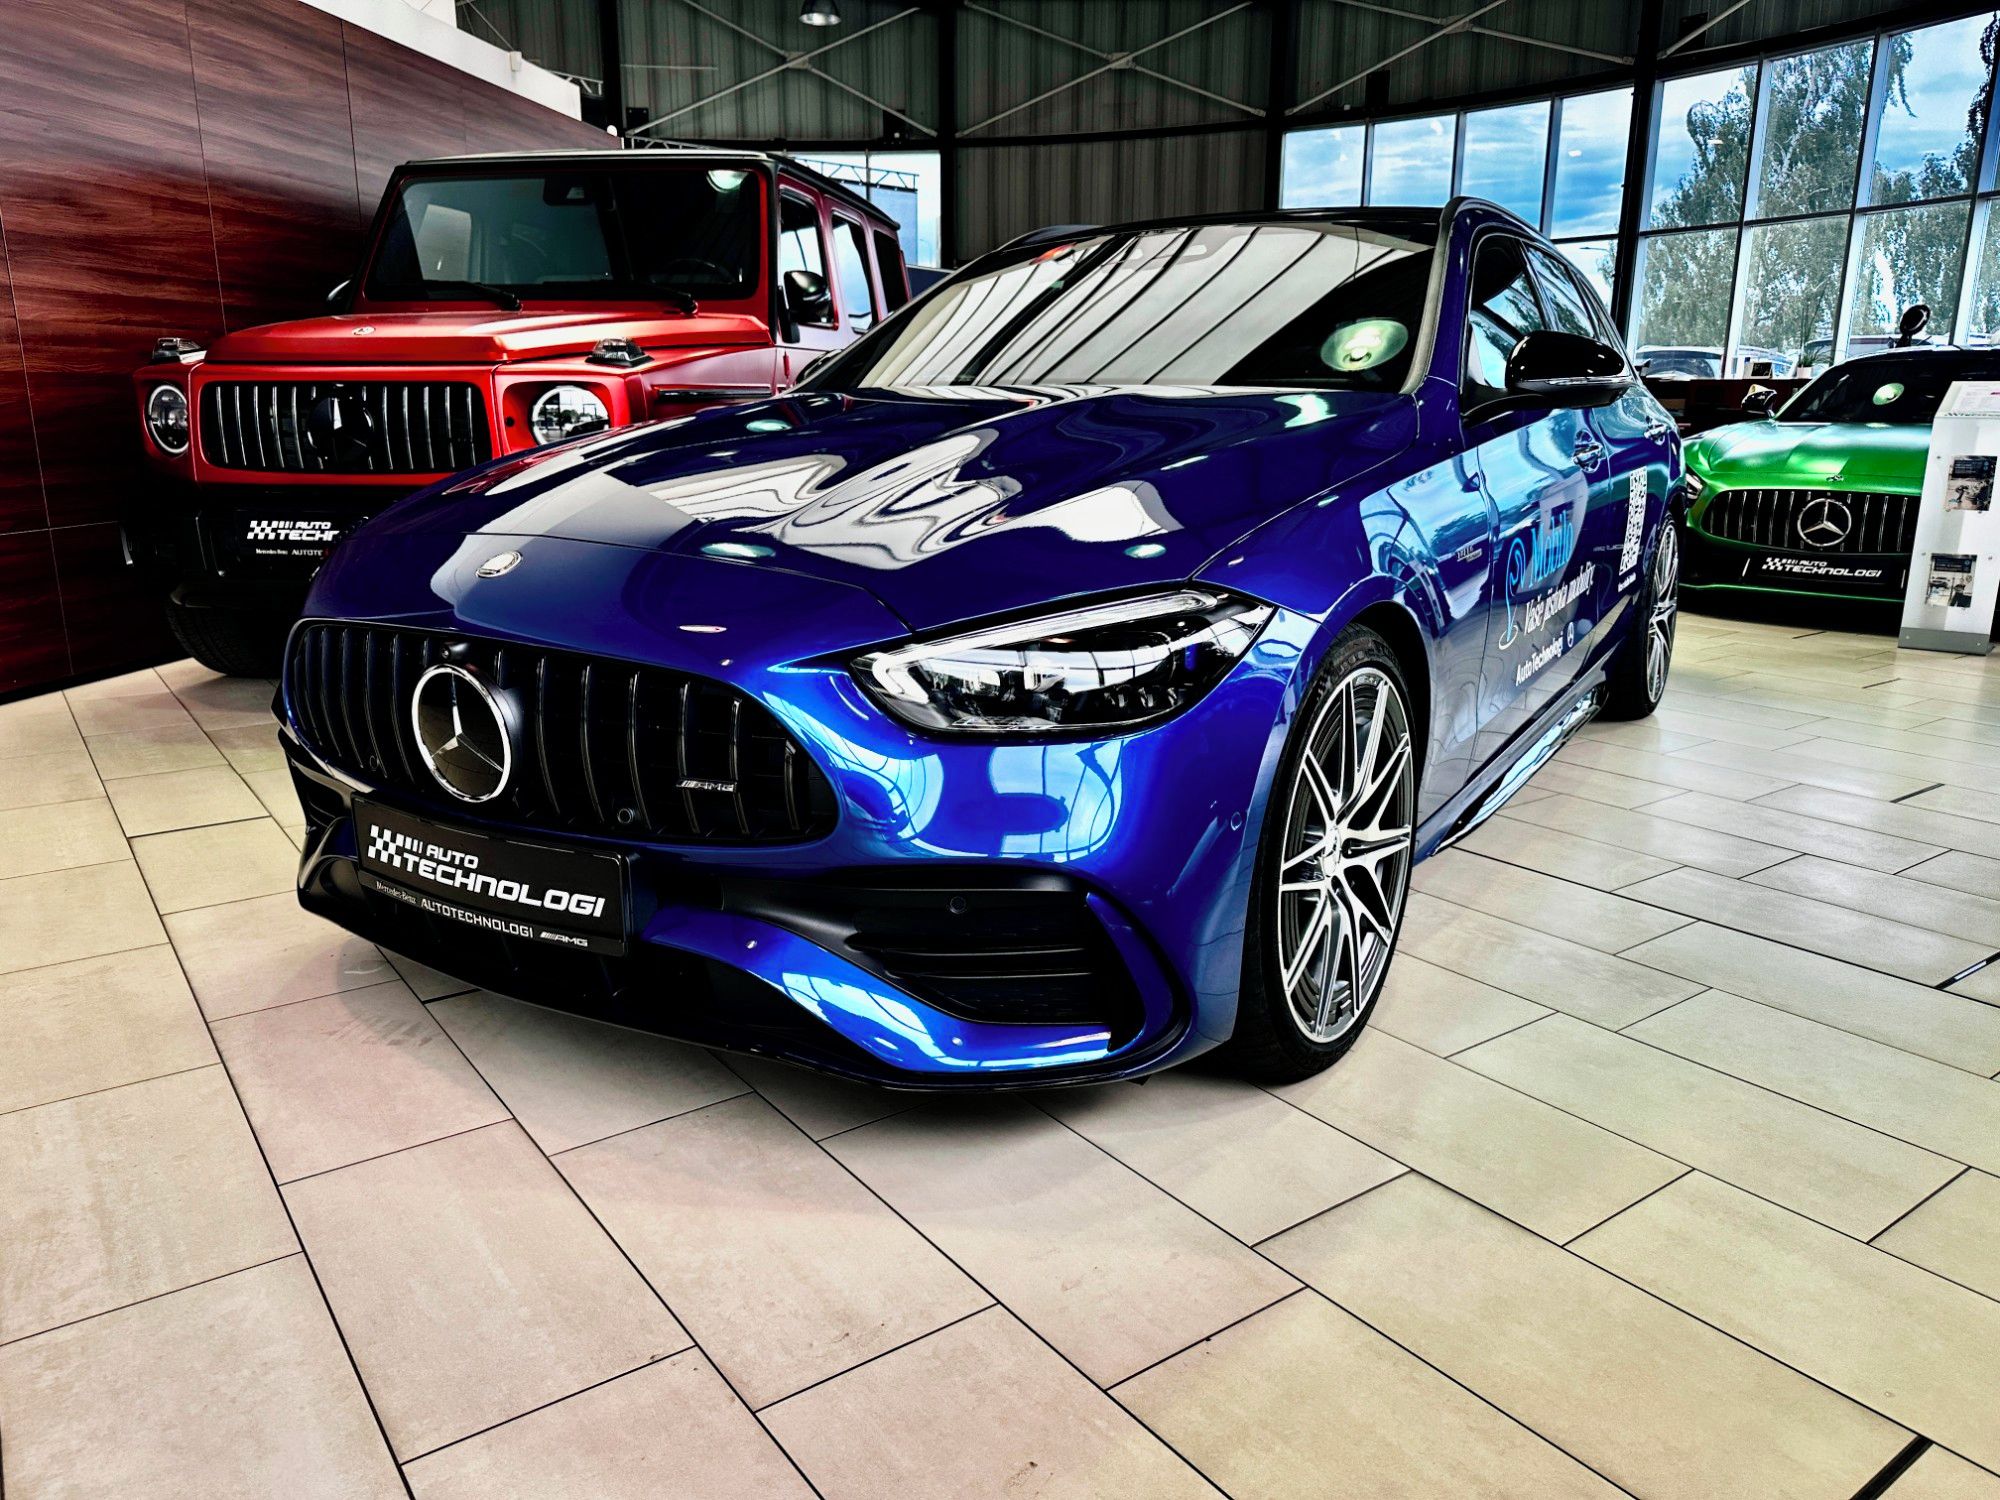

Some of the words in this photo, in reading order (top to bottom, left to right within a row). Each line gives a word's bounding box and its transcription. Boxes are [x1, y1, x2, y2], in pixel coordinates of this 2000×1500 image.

[295, 521, 331, 530] AUTO
[1529, 510, 1574, 588] Mobilo
[1783, 564, 1882, 578] TECHNOLOGI
[426, 844, 479, 869] AUTO
[403, 851, 606, 918] TECHNOLOGI
[376, 880, 417, 905] Mercedes-Benz
[420, 898, 533, 938] AUTOTECHNOLOGI
[555, 934, 588, 947] AMG
